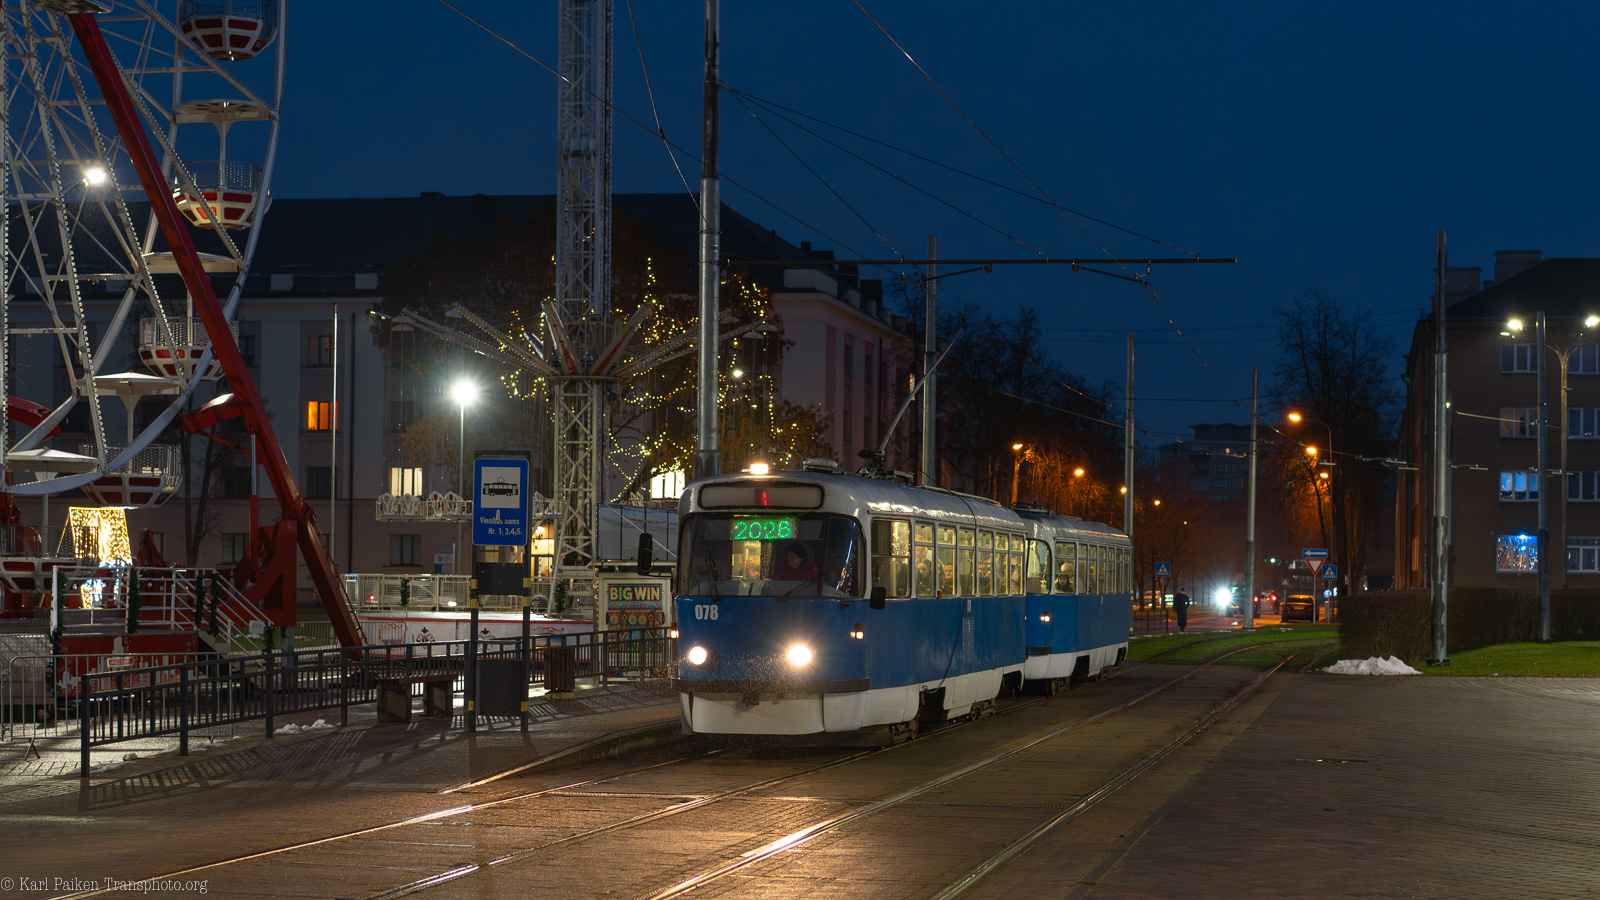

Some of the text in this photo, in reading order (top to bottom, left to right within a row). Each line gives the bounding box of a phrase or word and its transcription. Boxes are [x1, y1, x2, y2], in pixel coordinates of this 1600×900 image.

[734, 520, 792, 540] 2026
[610, 587, 660, 601] BIG WIN
[695, 605, 719, 620] 078
